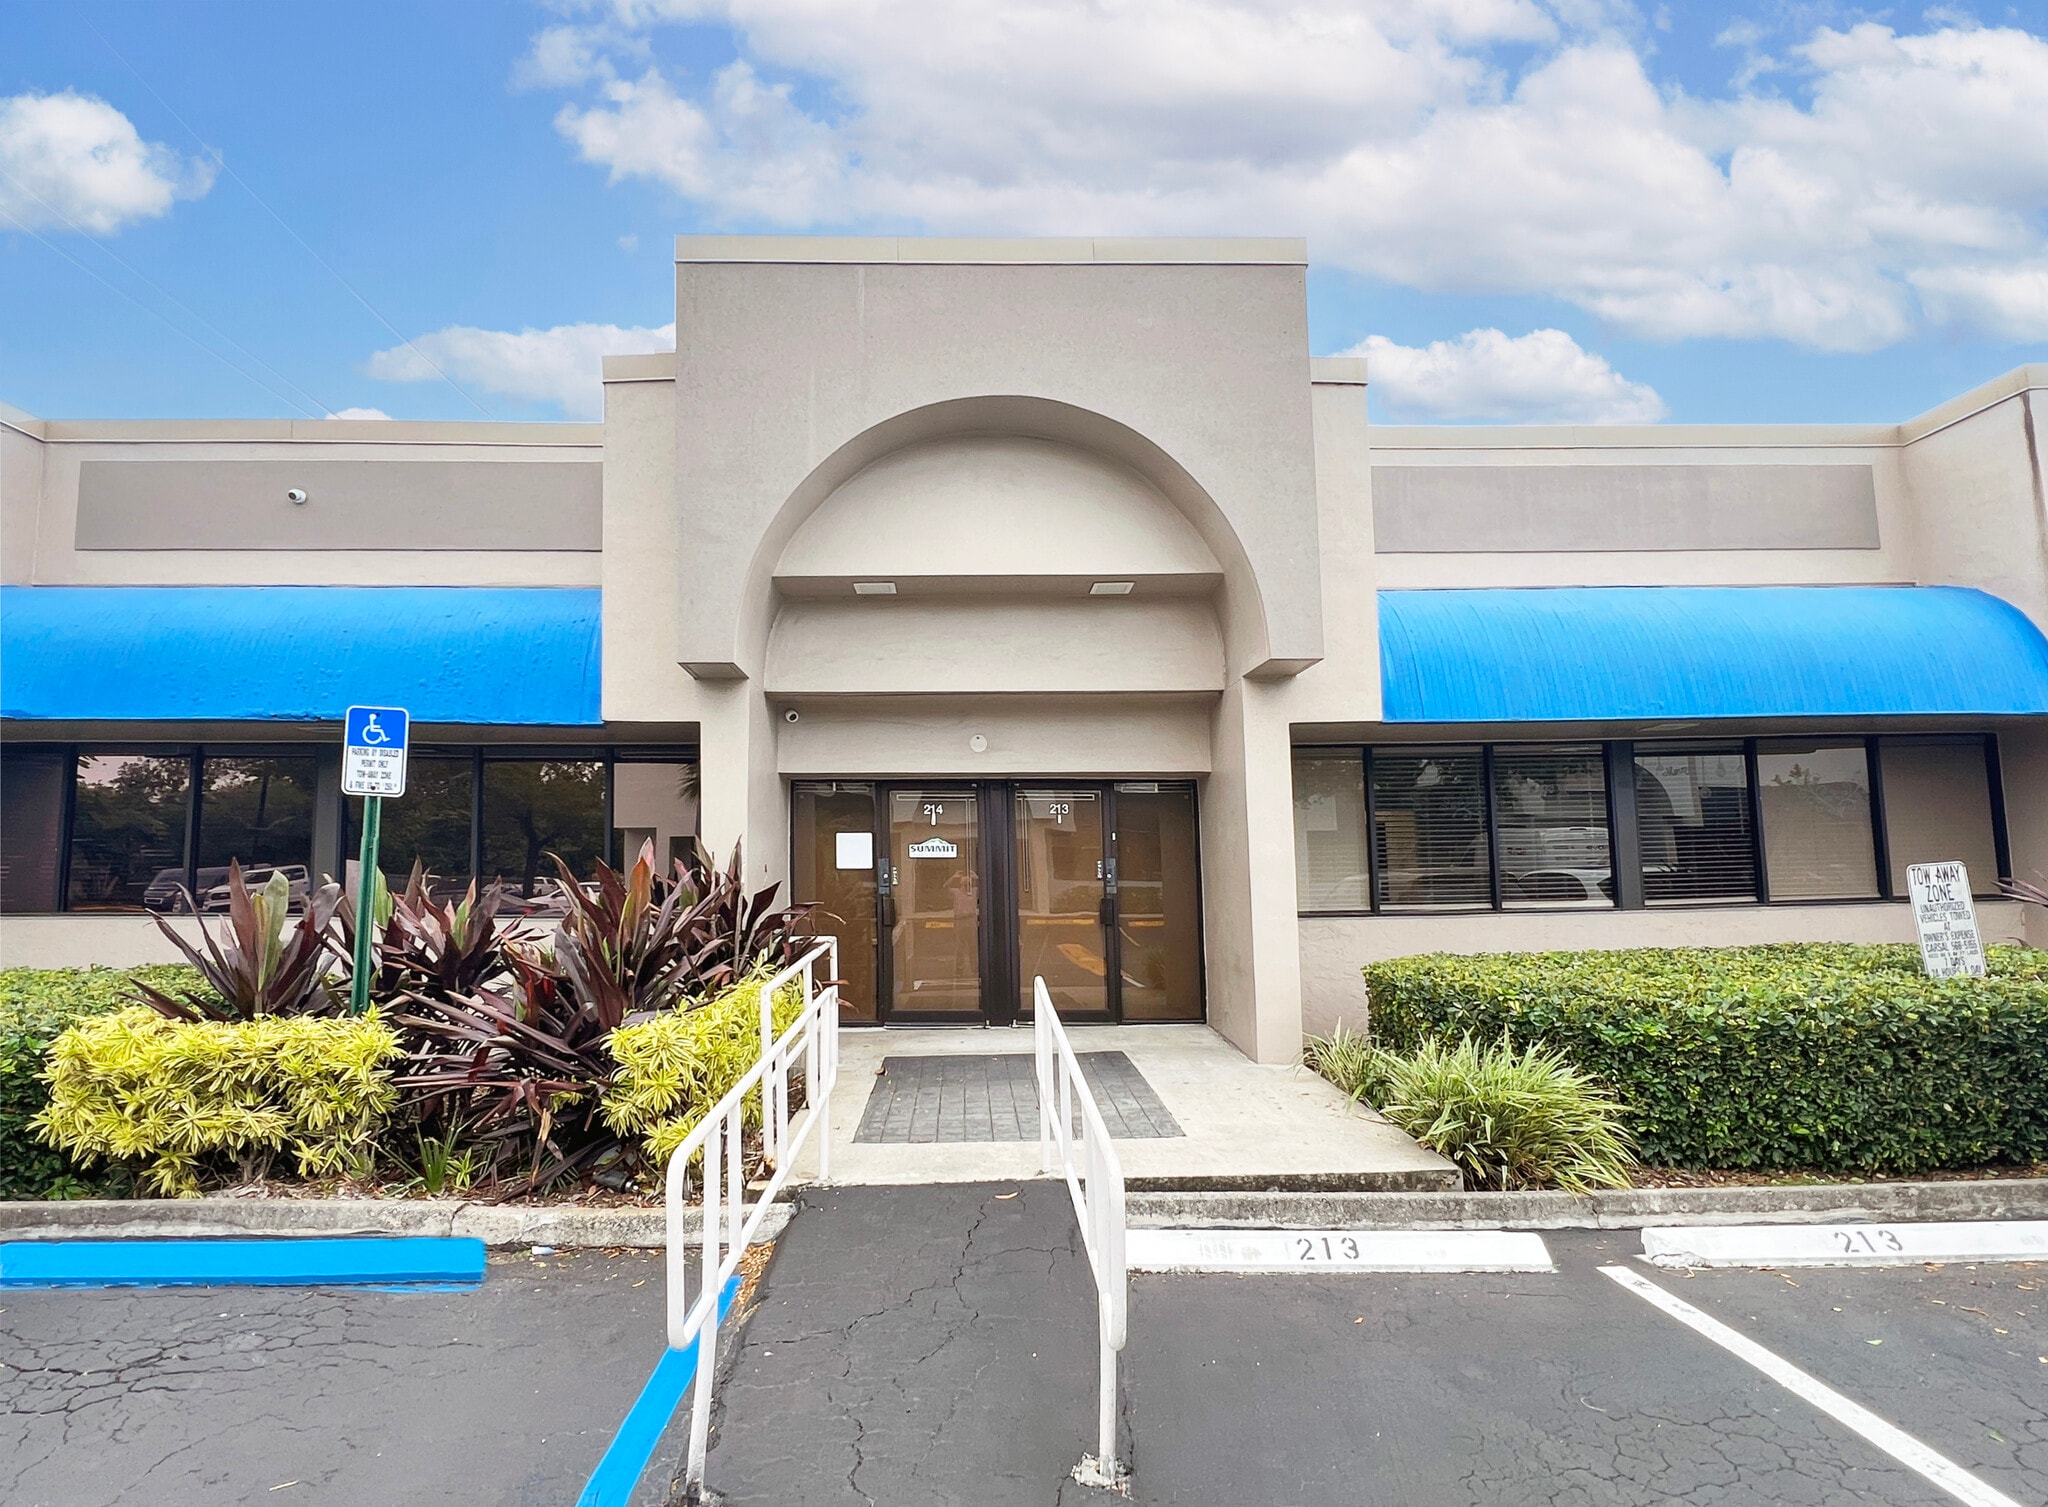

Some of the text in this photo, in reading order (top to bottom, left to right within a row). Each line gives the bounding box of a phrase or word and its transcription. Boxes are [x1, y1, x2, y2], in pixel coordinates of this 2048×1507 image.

[923, 804, 943, 815] 214
[1049, 803, 1069, 814] 213
[910, 845, 956, 853] SUMMIT
[1911, 864, 1961, 886] TOW AWAY
[1925, 883, 1955, 903] ZONE
[1920, 901, 1965, 914] UNAUTHORIZED
[1920, 910, 1971, 923] VEHICLES TOWED
[1950, 929, 1975, 940] EXPENSE
[1834, 1230, 1903, 1253] 213
[1296, 1237, 1360, 1260] 213
